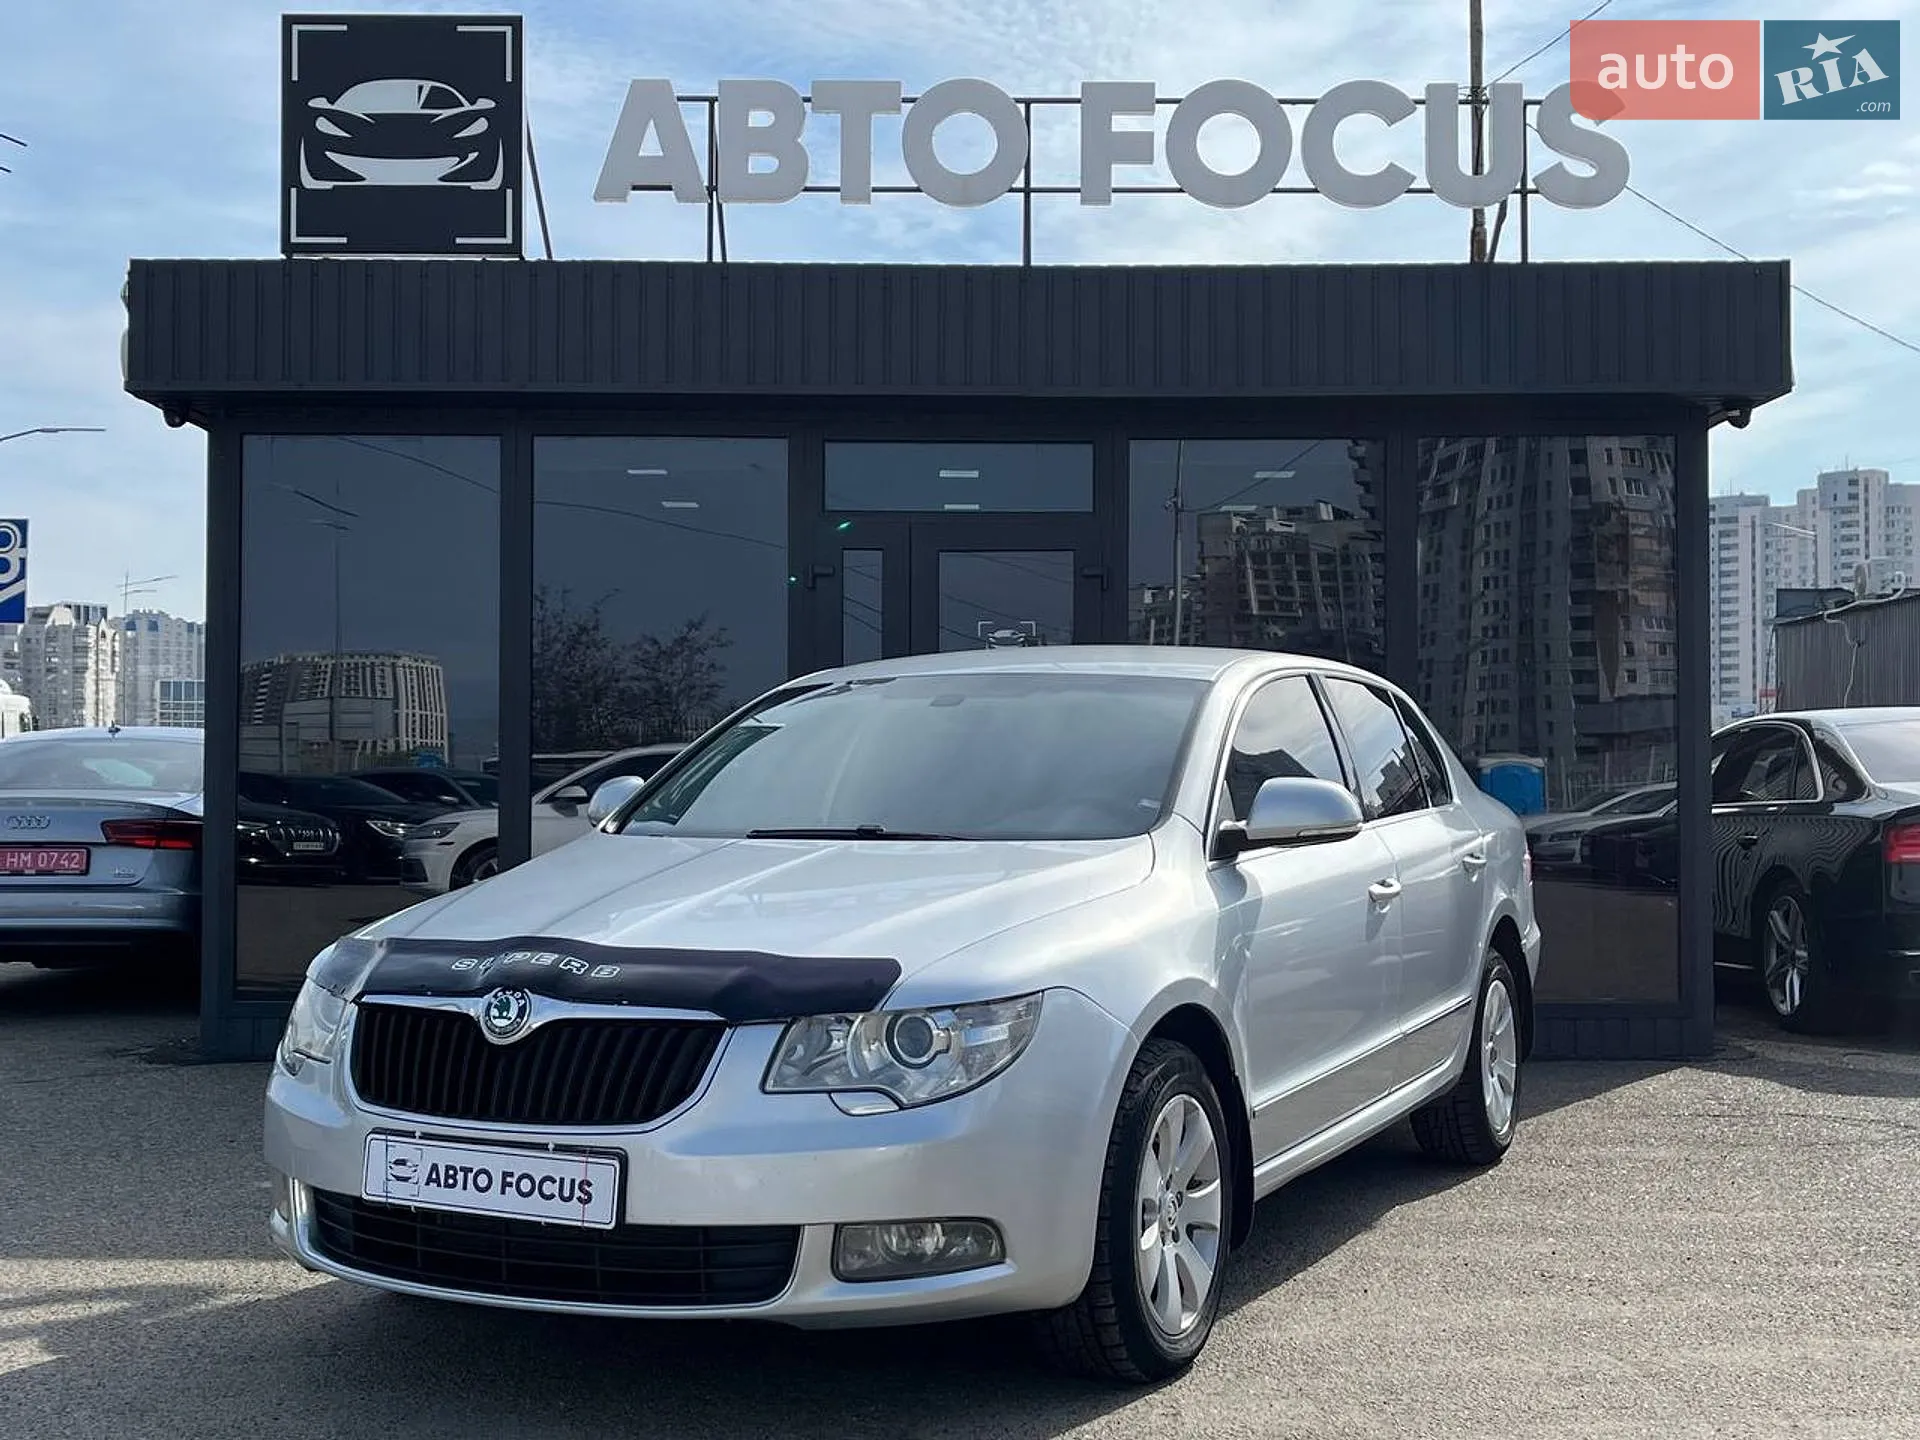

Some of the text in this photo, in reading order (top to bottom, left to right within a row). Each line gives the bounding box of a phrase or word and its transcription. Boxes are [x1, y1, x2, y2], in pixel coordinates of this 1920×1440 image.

[1080, 79, 1631, 210] FOCUS
[38, 852, 81, 868] 0742
[500, 1171, 594, 1205] FOCUS
